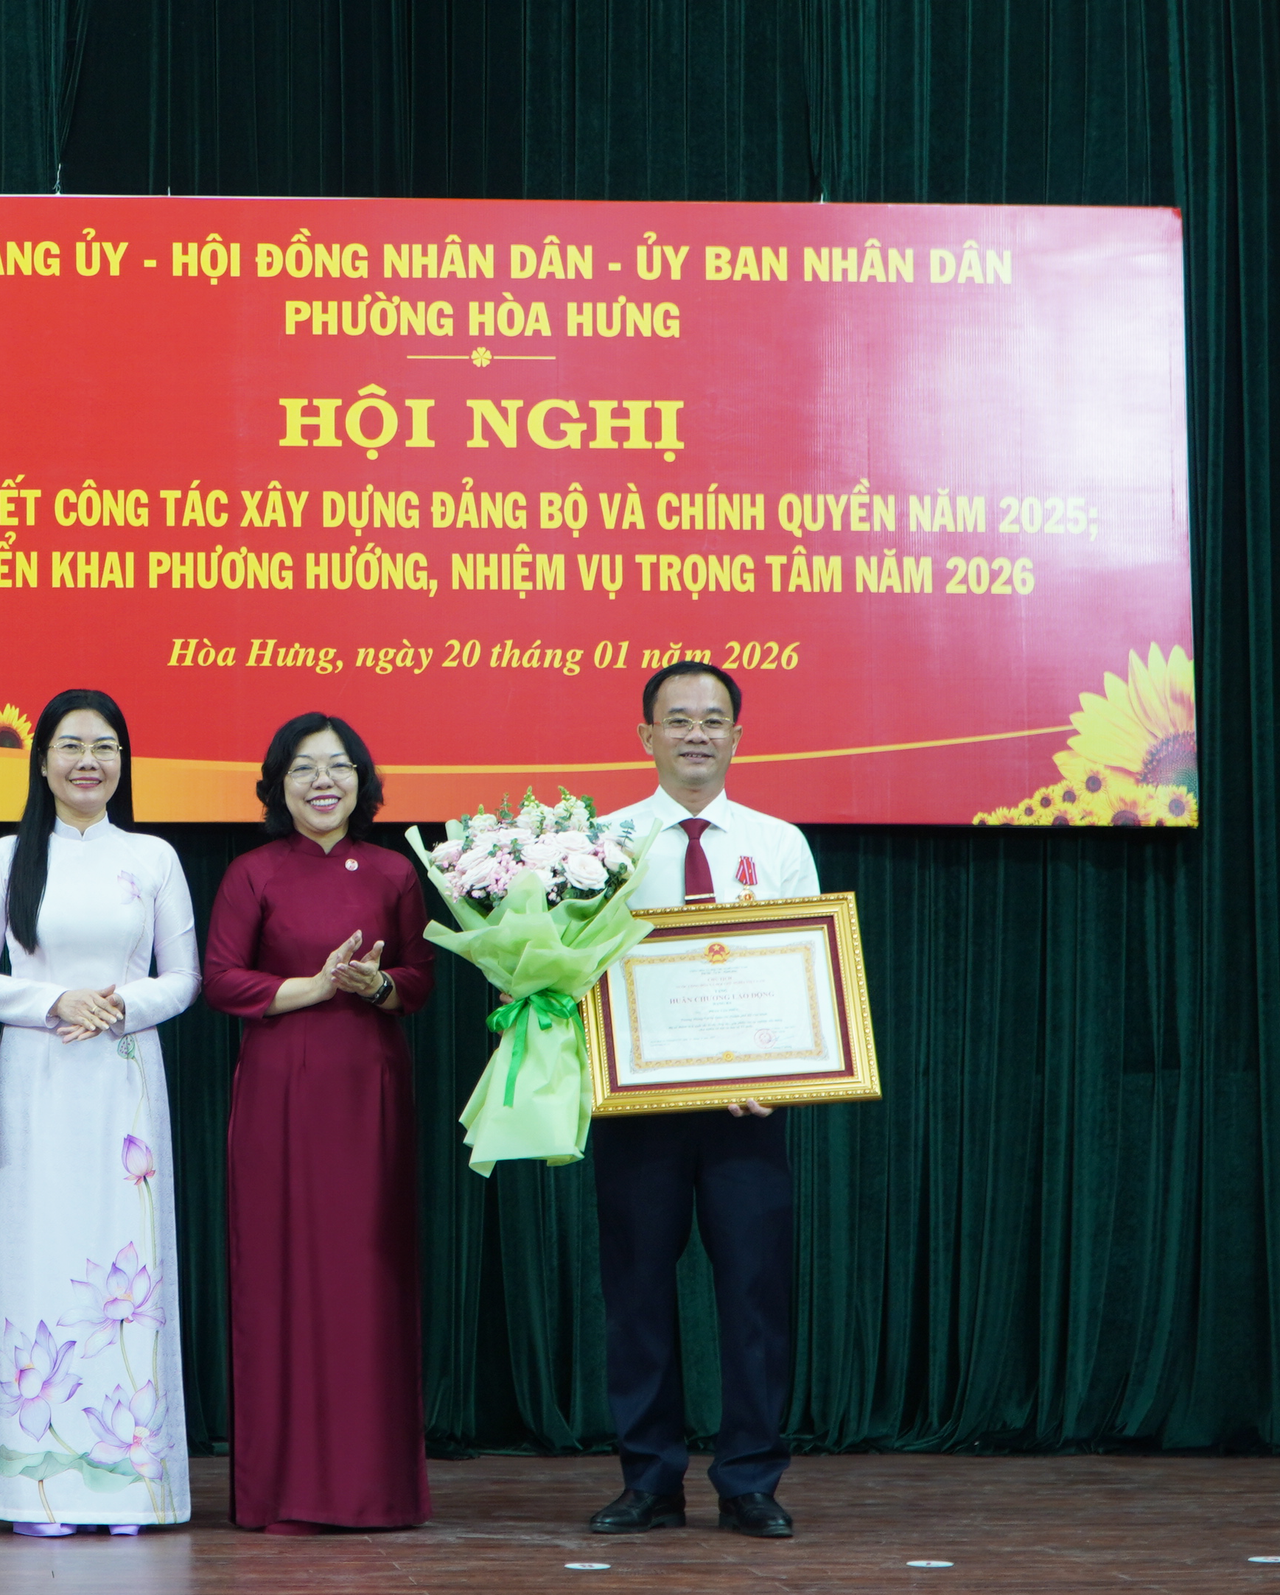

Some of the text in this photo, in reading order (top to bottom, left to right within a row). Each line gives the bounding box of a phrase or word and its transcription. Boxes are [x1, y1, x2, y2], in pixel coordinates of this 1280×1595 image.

[75, 227, 129, 277] ỦY
[172, 232, 241, 286] HỘI
[254, 227, 369, 279] ĐỒNG
[383, 233, 495, 279] NHÂN
[510, 234, 593, 280] DÂN
[636, 230, 690, 281] ỦY
[705, 245, 788, 282] BAN
[803, 238, 915, 283] NHÂN
[929, 239, 1012, 284] DÂN
[285, 290, 680, 338] PHƯỜNG HÒA HƯNG
[278, 383, 685, 463] HỘI NGHỊ
[54, 478, 149, 527] CÔNG
[159, 479, 229, 528] TÁC
[239, 480, 310, 528] XÂY
[322, 483, 420, 537] DỰNG
[430, 476, 527, 530] ĐẢNG
[539, 481, 588, 538] BỘ
[598, 482, 646, 530] VÀ
[656, 482, 765, 531] CHÍNH
[777, 478, 896, 538] QUYỀN
[909, 487, 987, 533] NĂM
[998, 496, 1097, 542] 2025;
[51, 551, 135, 589] KHAI
[148, 544, 294, 590] PHƯƠNG
[306, 540, 438, 598] HƯỚNG,
[451, 542, 566, 600] NHIỆM
[576, 553, 623, 600] VỤ
[634, 553, 755, 601] TRỌNG
[764, 544, 843, 593] TÂM
[855, 548, 934, 594] NĂM
[944, 555, 1036, 596] 2026
[167, 637, 800, 676] Hòa Hưng, ngày 20 tháng 01 năm 2026
